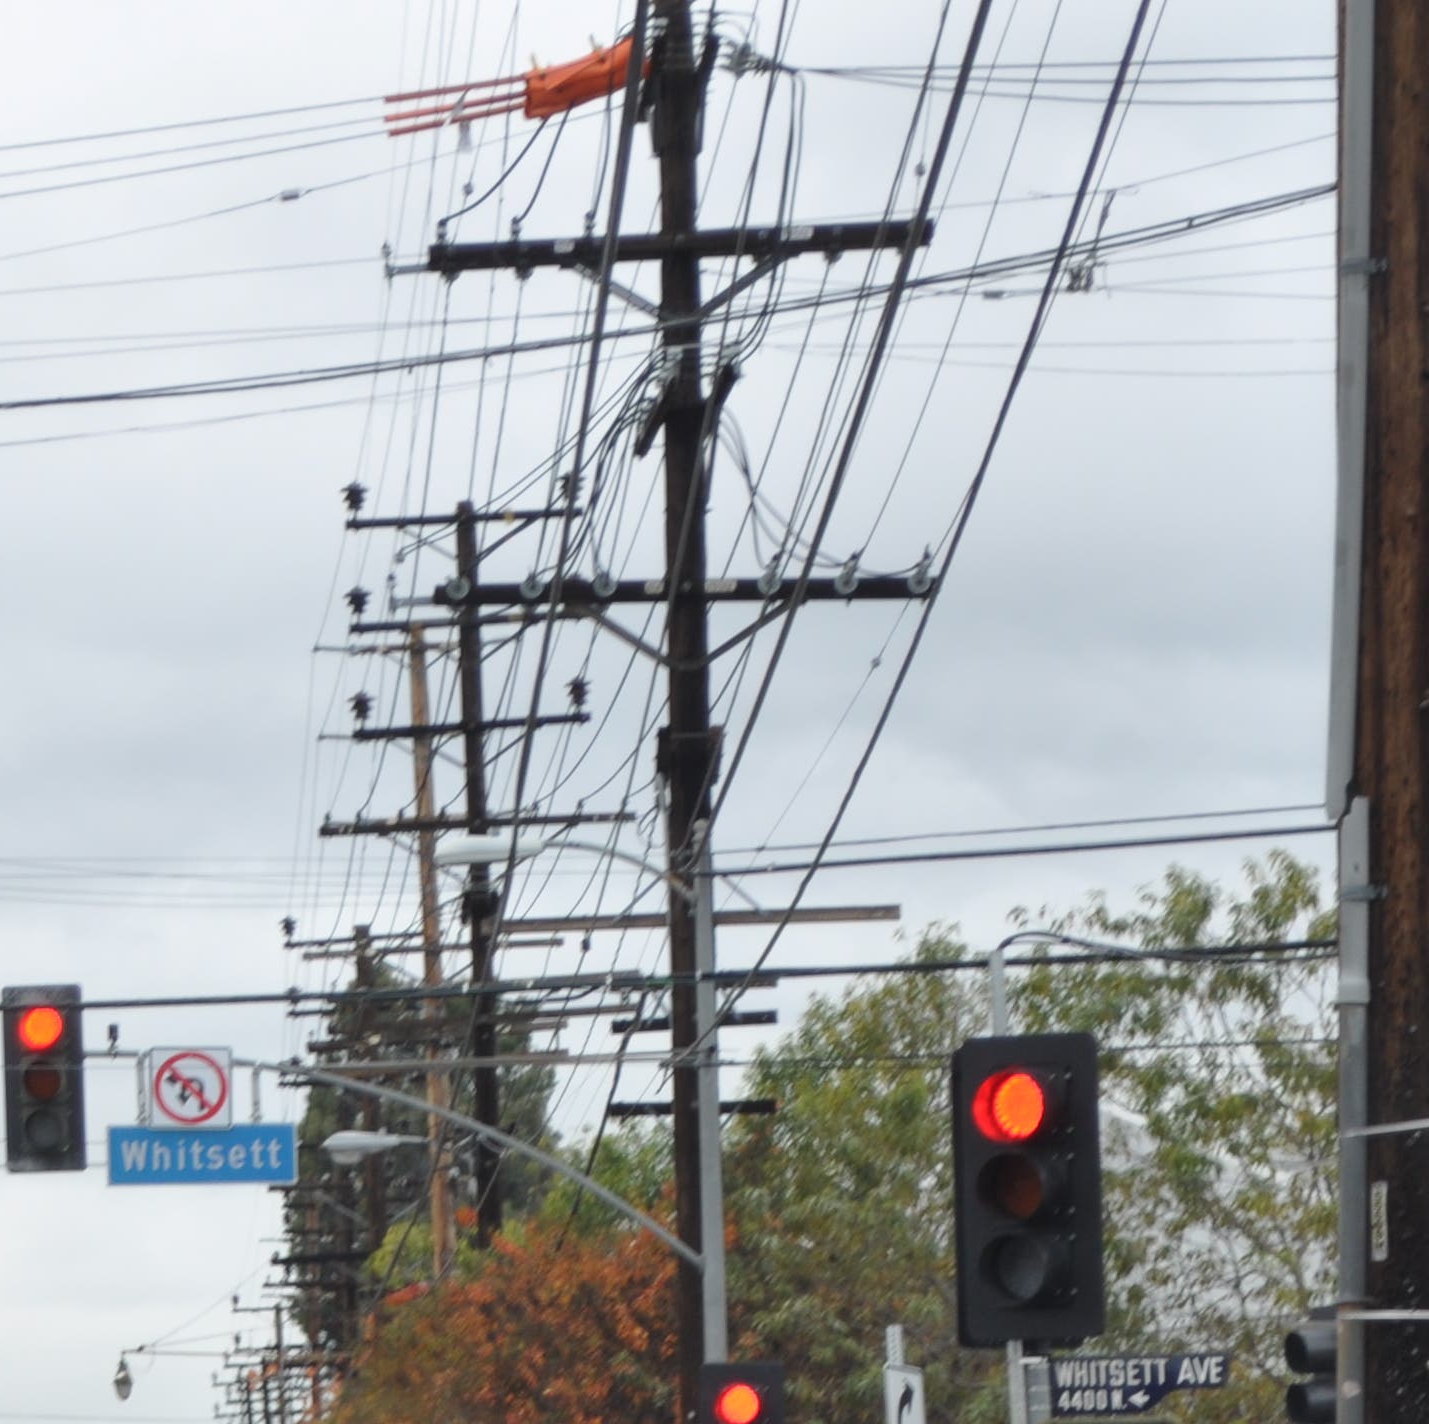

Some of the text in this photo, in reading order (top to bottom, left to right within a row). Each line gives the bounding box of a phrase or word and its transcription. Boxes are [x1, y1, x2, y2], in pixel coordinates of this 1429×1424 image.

[120, 1138, 283, 1172] Whitsett
[1054, 1355, 1225, 1388] WHITSETT AVE
